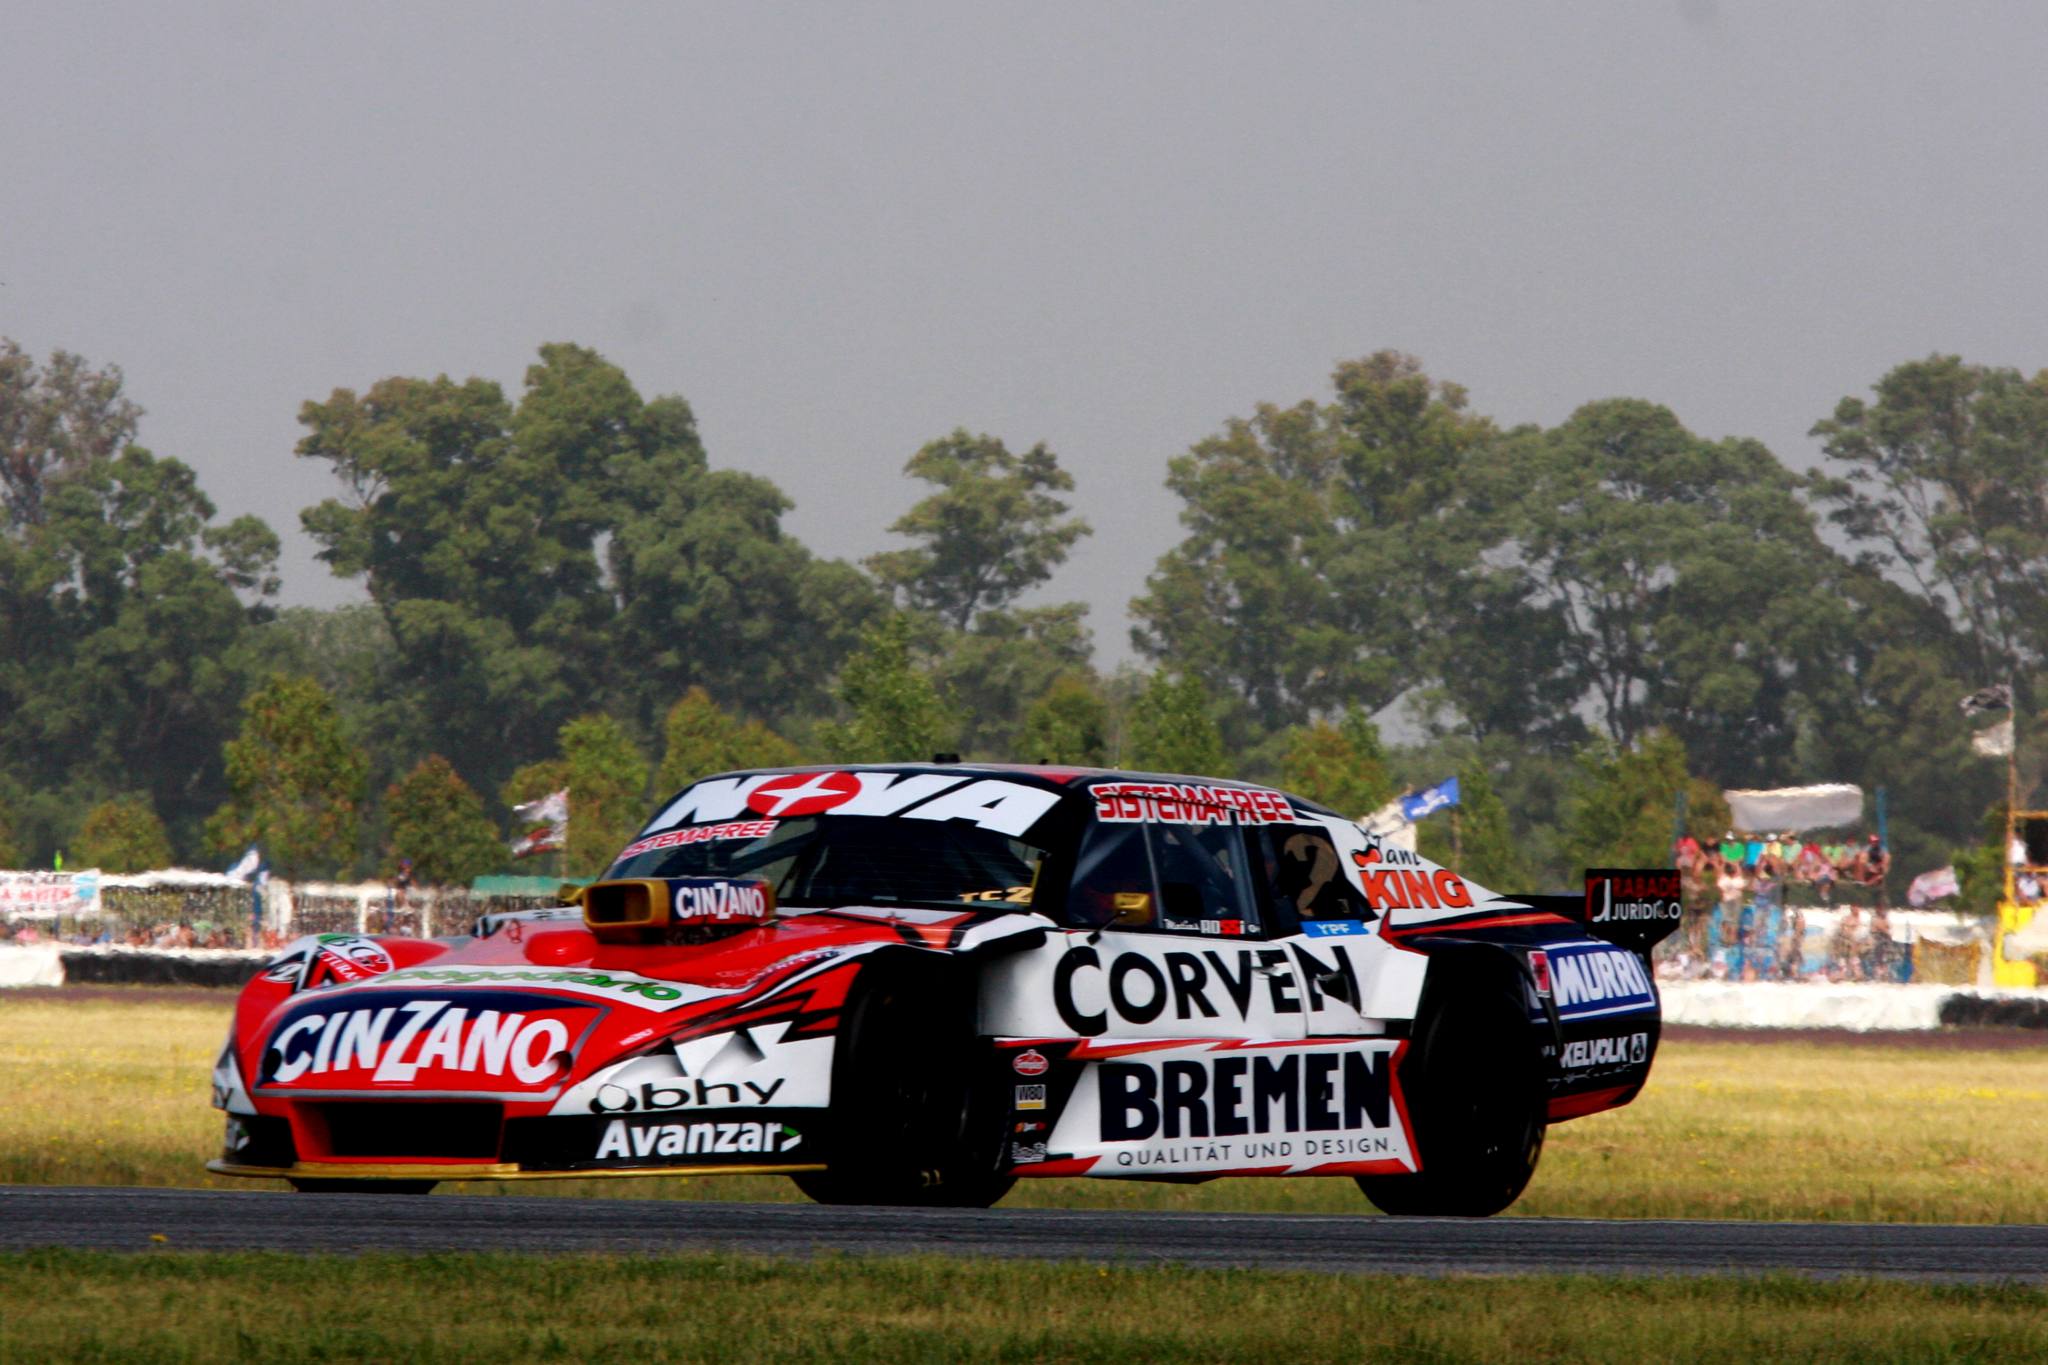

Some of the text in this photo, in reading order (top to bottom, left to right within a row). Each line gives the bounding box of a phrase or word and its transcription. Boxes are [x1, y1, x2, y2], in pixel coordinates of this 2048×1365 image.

[1092, 784, 1296, 825] SISTEMAFREE
[675, 882, 765, 920] CINZANO
[1359, 869, 1474, 909] KING
[1316, 922, 1351, 936] YPF
[1053, 944, 1362, 1038] CORVEN
[272, 1000, 569, 1084] CINZANO
[1097, 1050, 1391, 1142] BREMEN
[595, 1119, 782, 1159] Avanzar
[1117, 1142, 1233, 1167] QUALITÄT
[1244, 1141, 1292, 1158] UND
